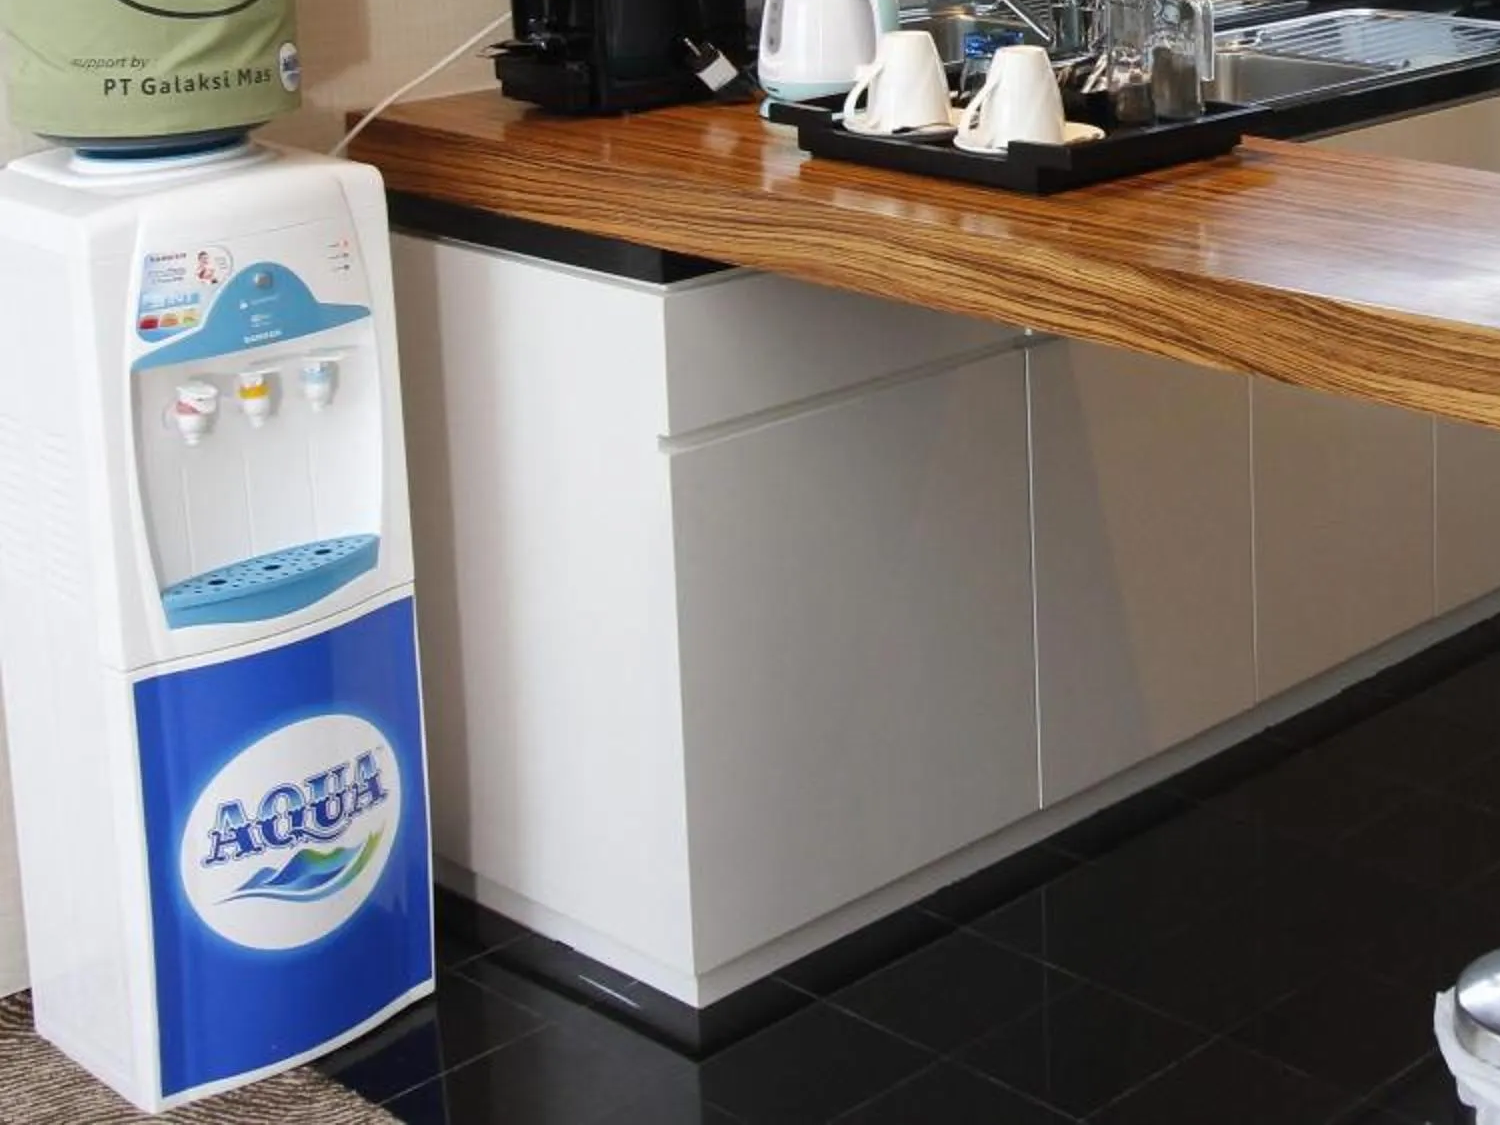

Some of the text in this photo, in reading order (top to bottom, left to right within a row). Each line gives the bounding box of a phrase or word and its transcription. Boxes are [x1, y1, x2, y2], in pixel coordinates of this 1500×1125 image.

[103, 68, 272, 96] PT Galaksi Mas
[201, 748, 388, 868] AQUA
